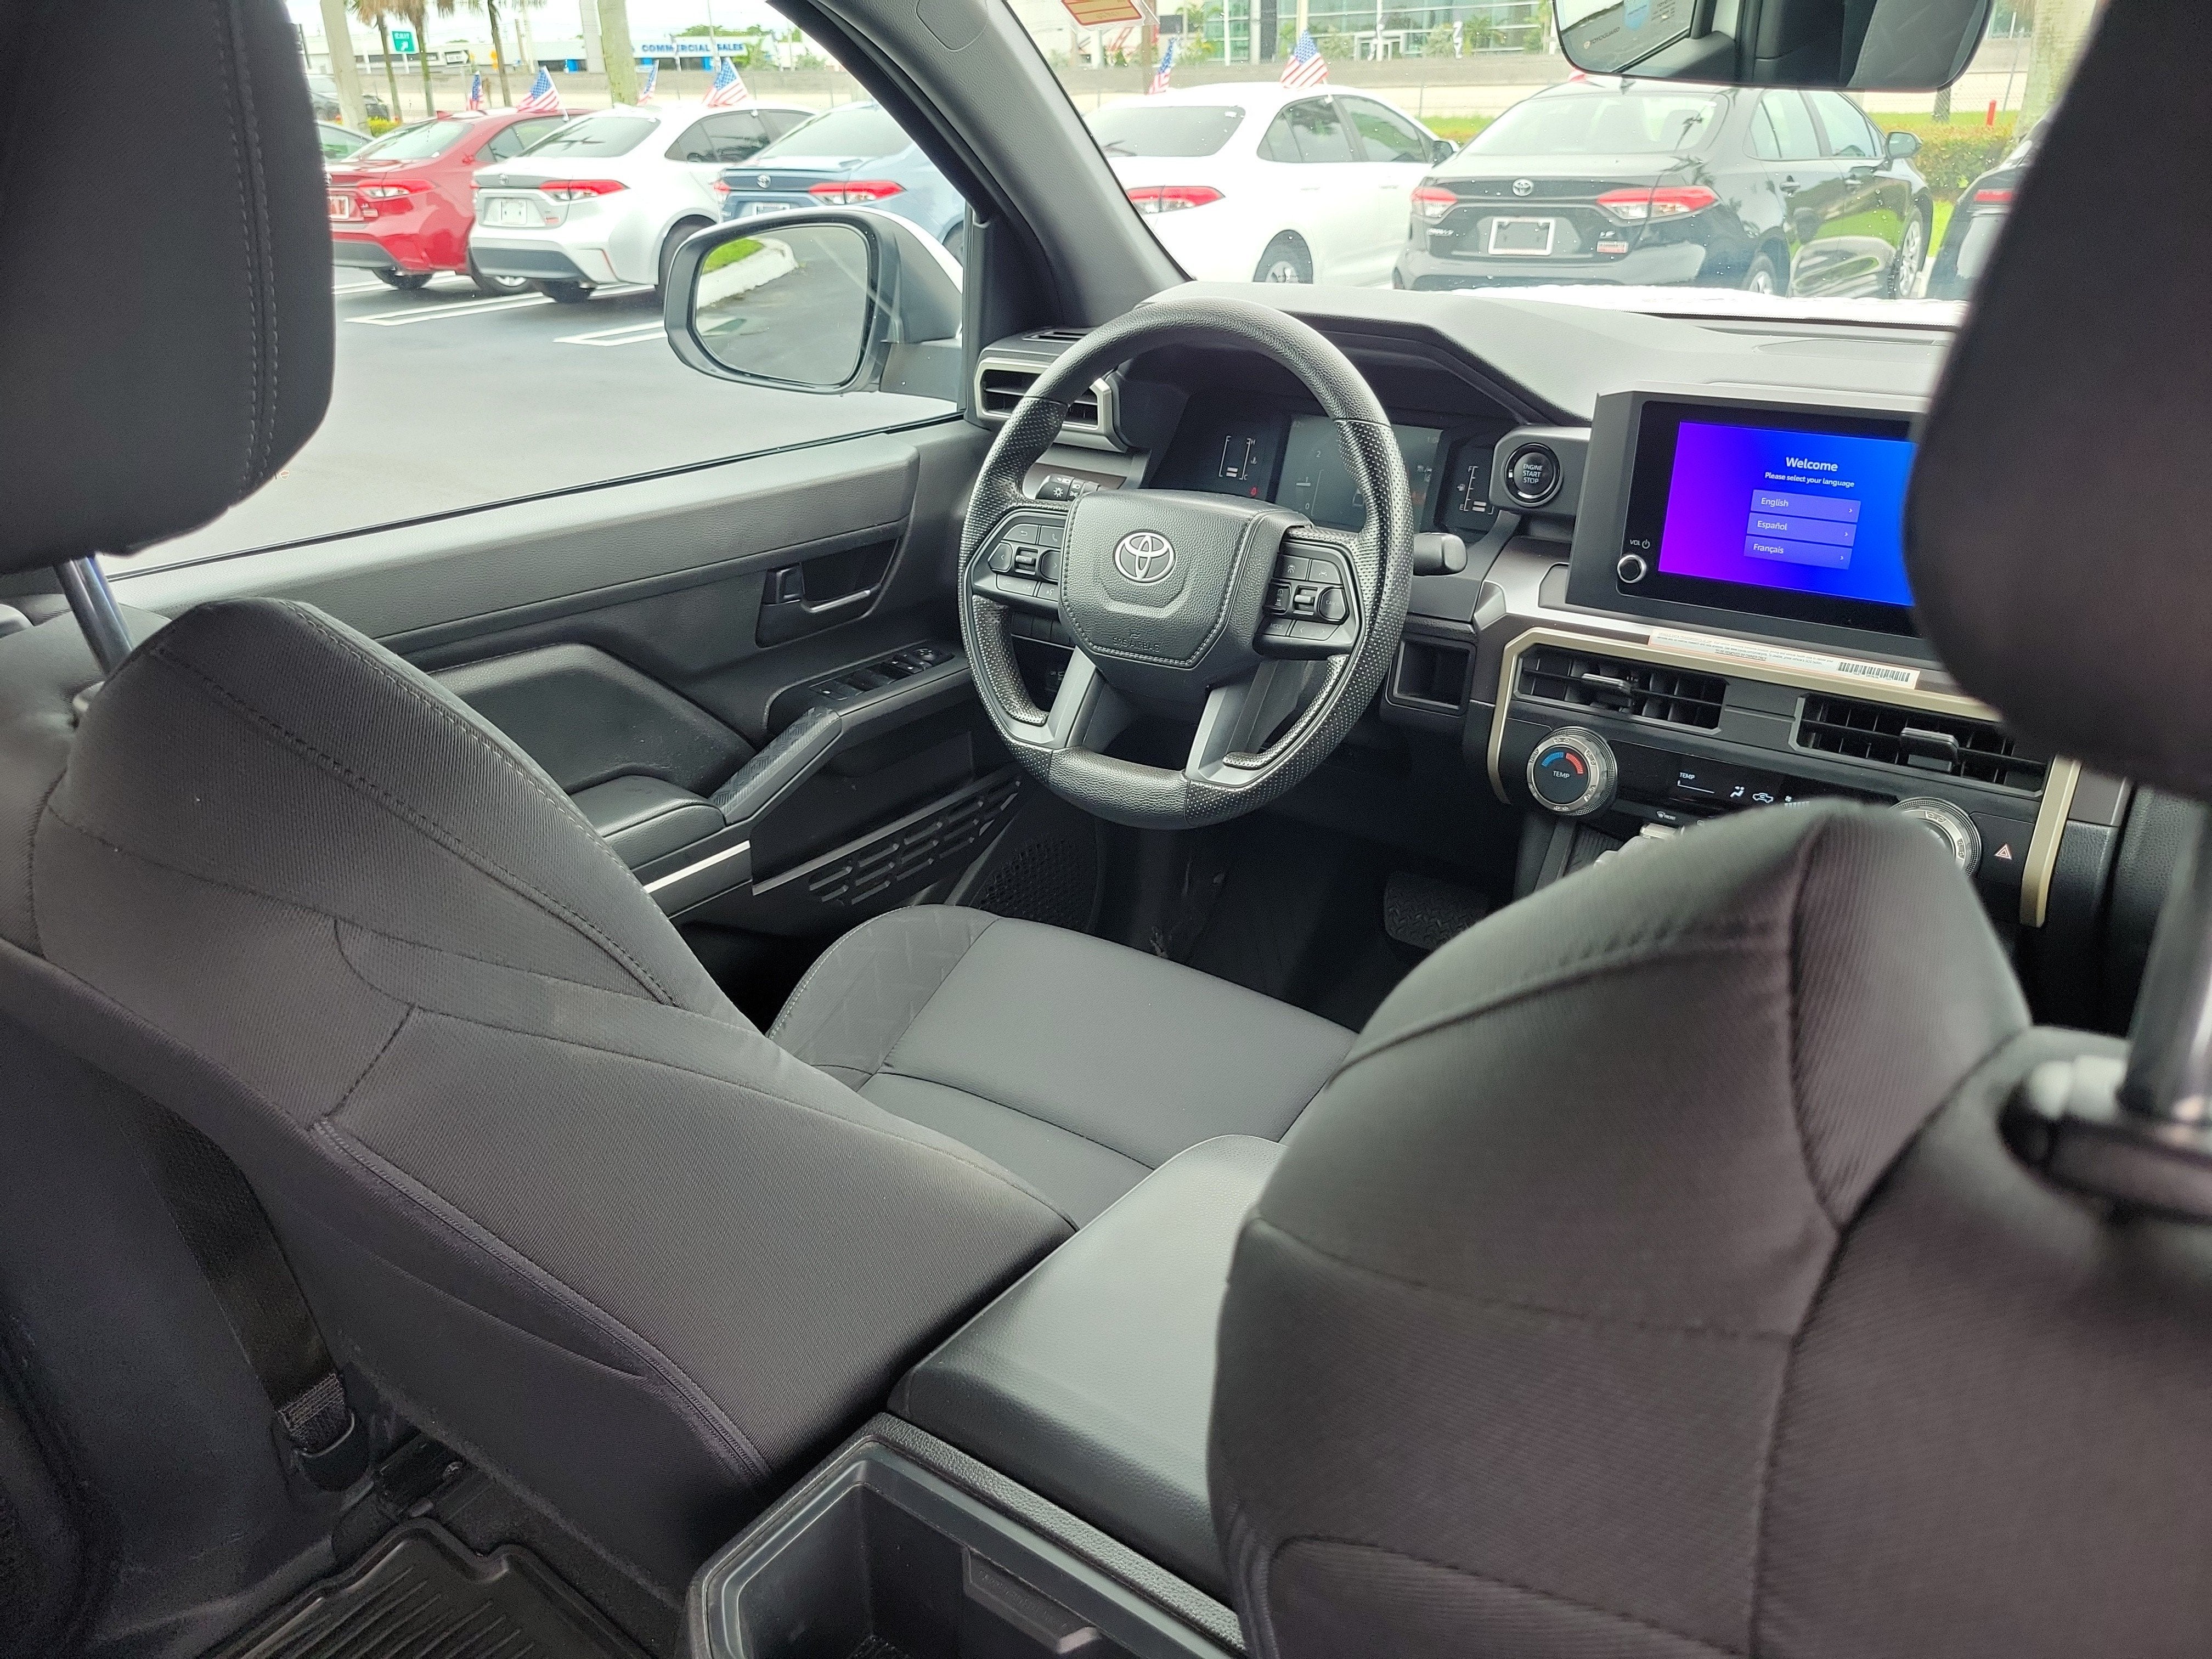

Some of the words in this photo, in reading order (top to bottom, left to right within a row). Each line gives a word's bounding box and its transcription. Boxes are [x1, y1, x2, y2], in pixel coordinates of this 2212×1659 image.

[1786, 457, 1838, 472] Welcome
[1765, 472, 1786, 480] Please
[1786, 475, 1806, 483] select
[1822, 477, 1855, 488] language
[1761, 498, 1788, 507] English
[1757, 521, 1787, 531] Español
[1753, 543, 1784, 554] Français
[1553, 770, 1570, 779] TEMP
